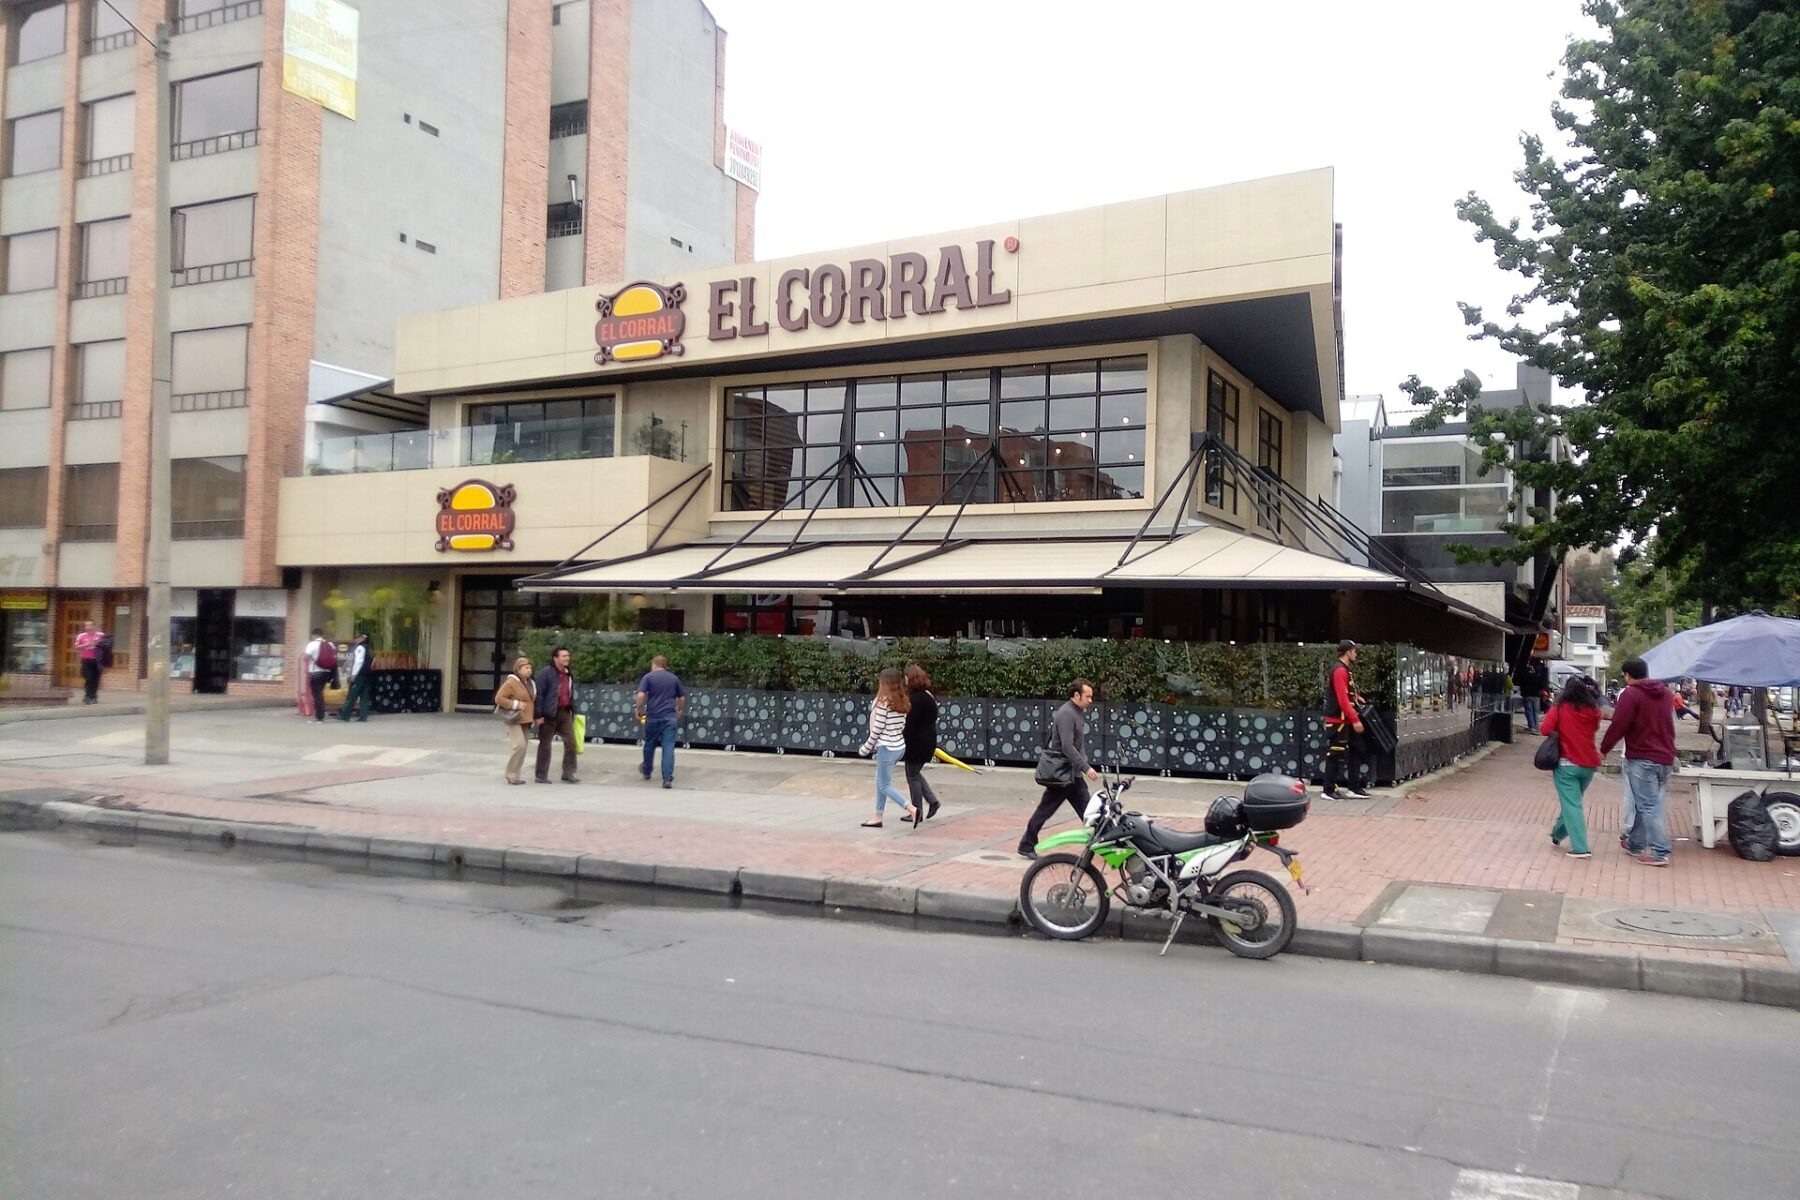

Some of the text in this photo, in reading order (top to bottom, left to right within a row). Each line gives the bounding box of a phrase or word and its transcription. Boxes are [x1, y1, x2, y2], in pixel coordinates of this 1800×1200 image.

[708, 240, 1012, 341] EL CORRAL
[601, 316, 675, 341] EL CORRAL
[440, 513, 506, 532] EL CORRAL
